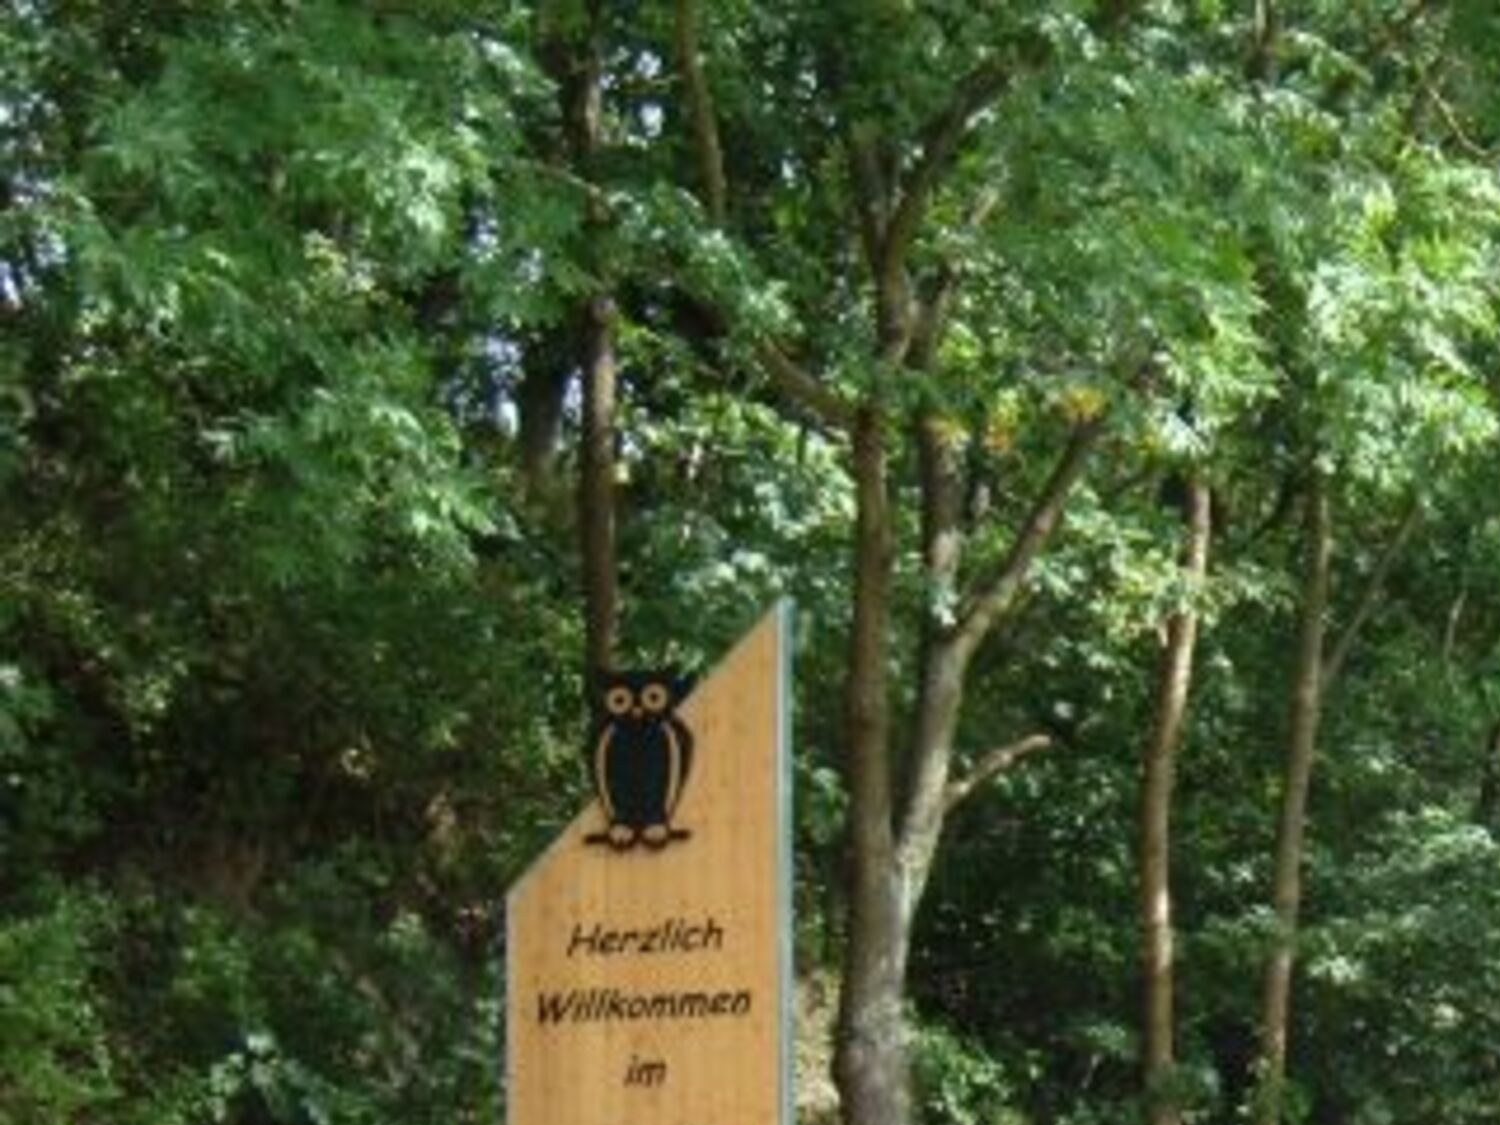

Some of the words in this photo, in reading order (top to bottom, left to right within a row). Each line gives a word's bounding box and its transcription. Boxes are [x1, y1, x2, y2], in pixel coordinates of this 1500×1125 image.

[566, 918, 723, 957] Herzlich
[537, 988, 751, 1025] Willkommen
[624, 1054, 667, 1087] im
